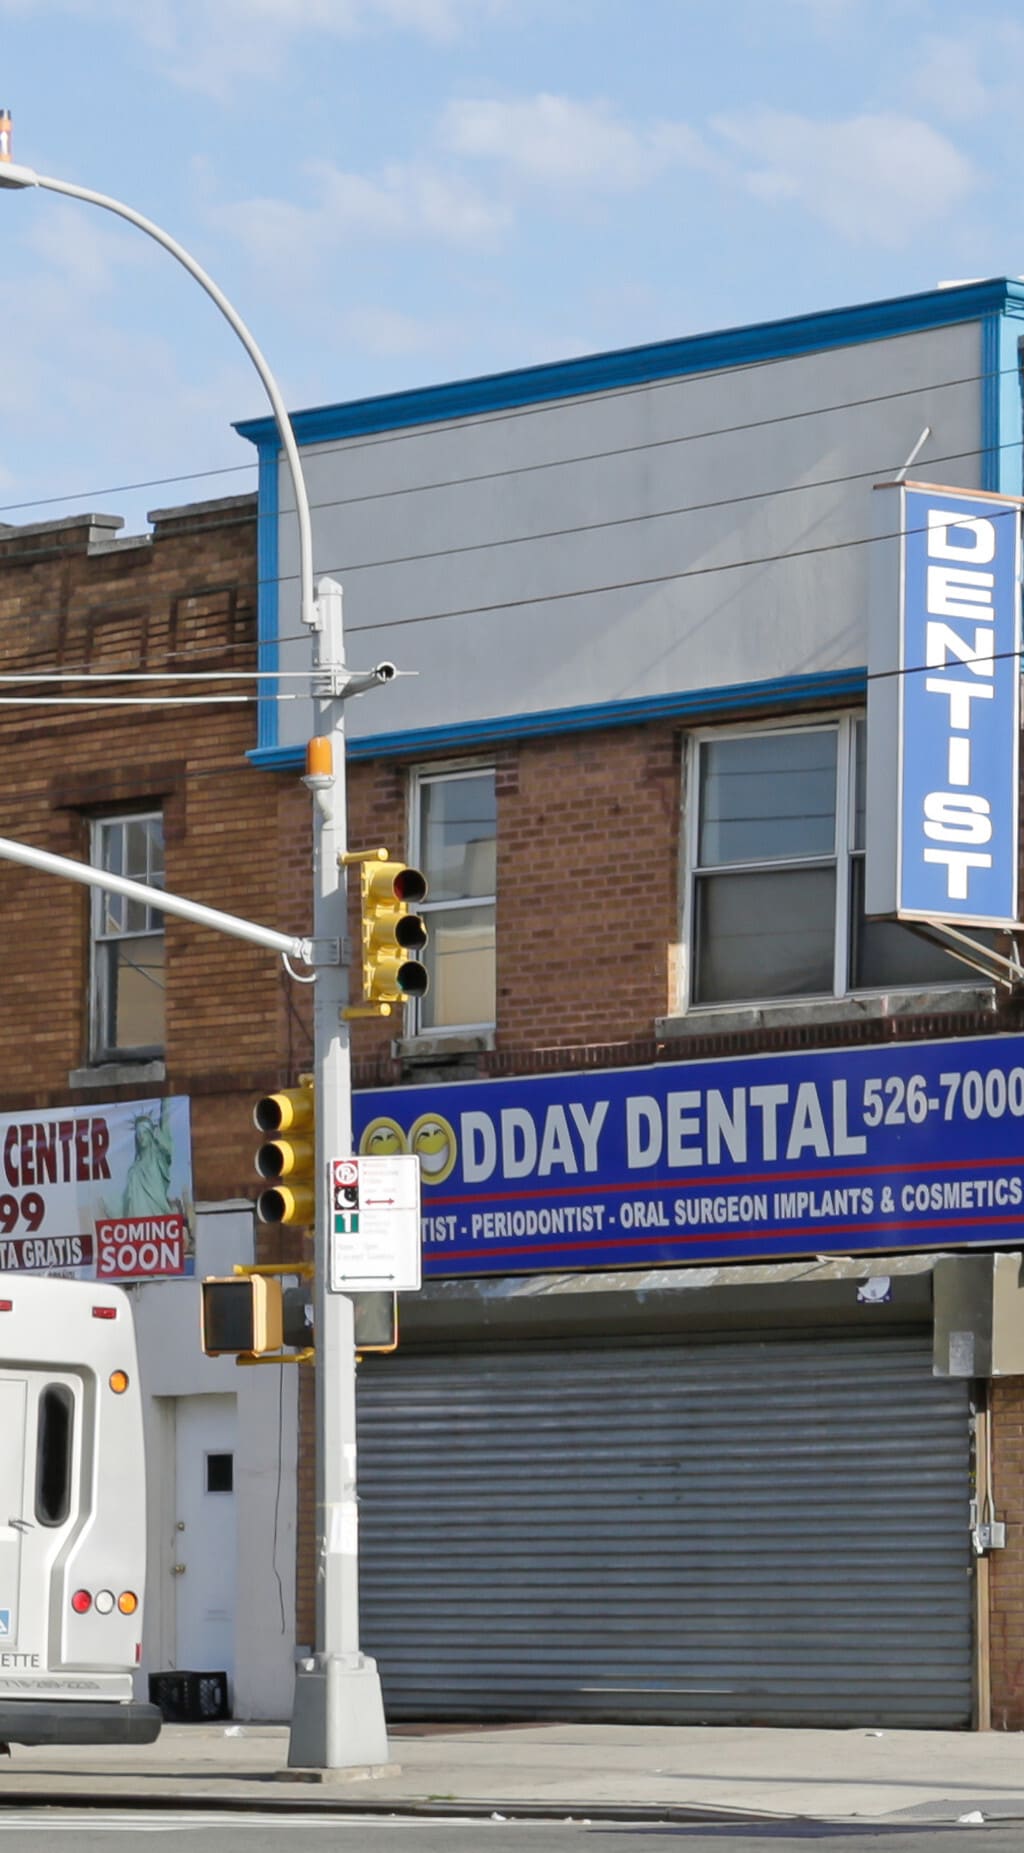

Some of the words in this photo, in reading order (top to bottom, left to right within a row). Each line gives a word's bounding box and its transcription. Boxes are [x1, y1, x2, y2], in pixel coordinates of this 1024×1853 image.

[923, 509, 996, 899] DENTIST
[4, 1118, 111, 1188] CENTER
[626, 1079, 867, 1169] DENTAL
[100, 1220, 179, 1245] COMING
[471, 1205, 605, 1239] PERIODONTIST
[620, 1200, 669, 1228] ORAL
[674, 1195, 768, 1226] SURGEON
[773, 1187, 874, 1219] IMPLANTS
[880, 1186, 895, 1212] &
[901, 1177, 1023, 1212] COSMETICS
[22, 1237, 83, 1267] GRATIS
[101, 1242, 180, 1272] SOON
